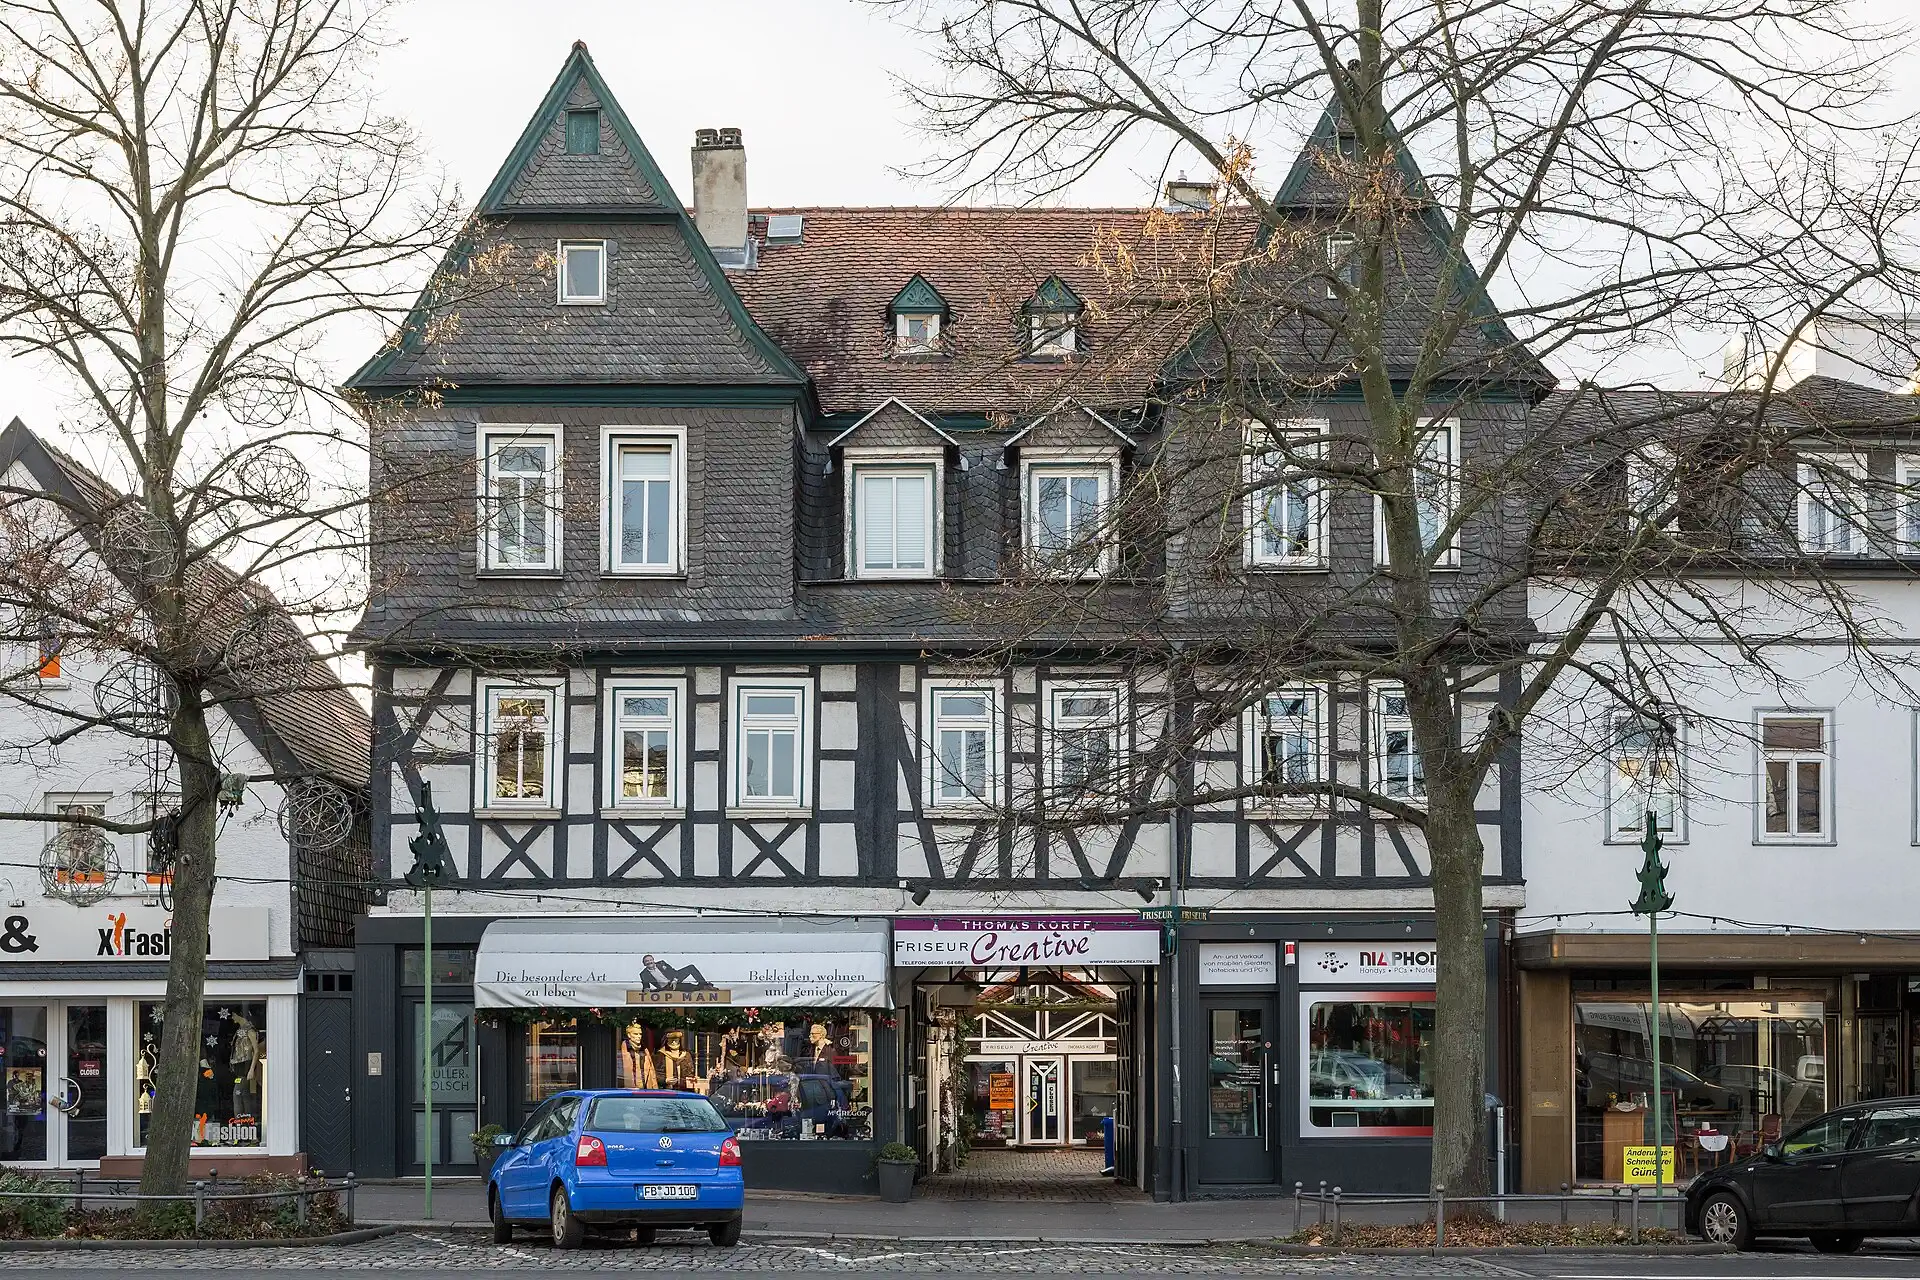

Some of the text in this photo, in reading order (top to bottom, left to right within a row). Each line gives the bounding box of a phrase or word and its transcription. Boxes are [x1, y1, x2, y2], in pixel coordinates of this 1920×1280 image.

[1142, 910, 1173, 920] FRISEUR
[1181, 911, 1207, 921] FRISEUR
[961, 920, 1092, 930] THOMAS KORFF
[0, 915, 40, 953] &
[124, 928, 211, 956] Fash
[895, 931, 1090, 965] FRISEUR Creative
[495, 969, 608, 983] Die besondere Art
[749, 968, 866, 983] Bekleiden, wohnen
[1359, 966, 1438, 975] Handys PCs Noteb
[524, 983, 577, 997] zu leben
[765, 983, 849, 999] und genießen
[638, 992, 718, 1002] TOP MAN
[1022, 1041, 1059, 1053] Creative
[80, 1068, 100, 1076] CLOSED
[644, 1186, 658, 1197] FB
